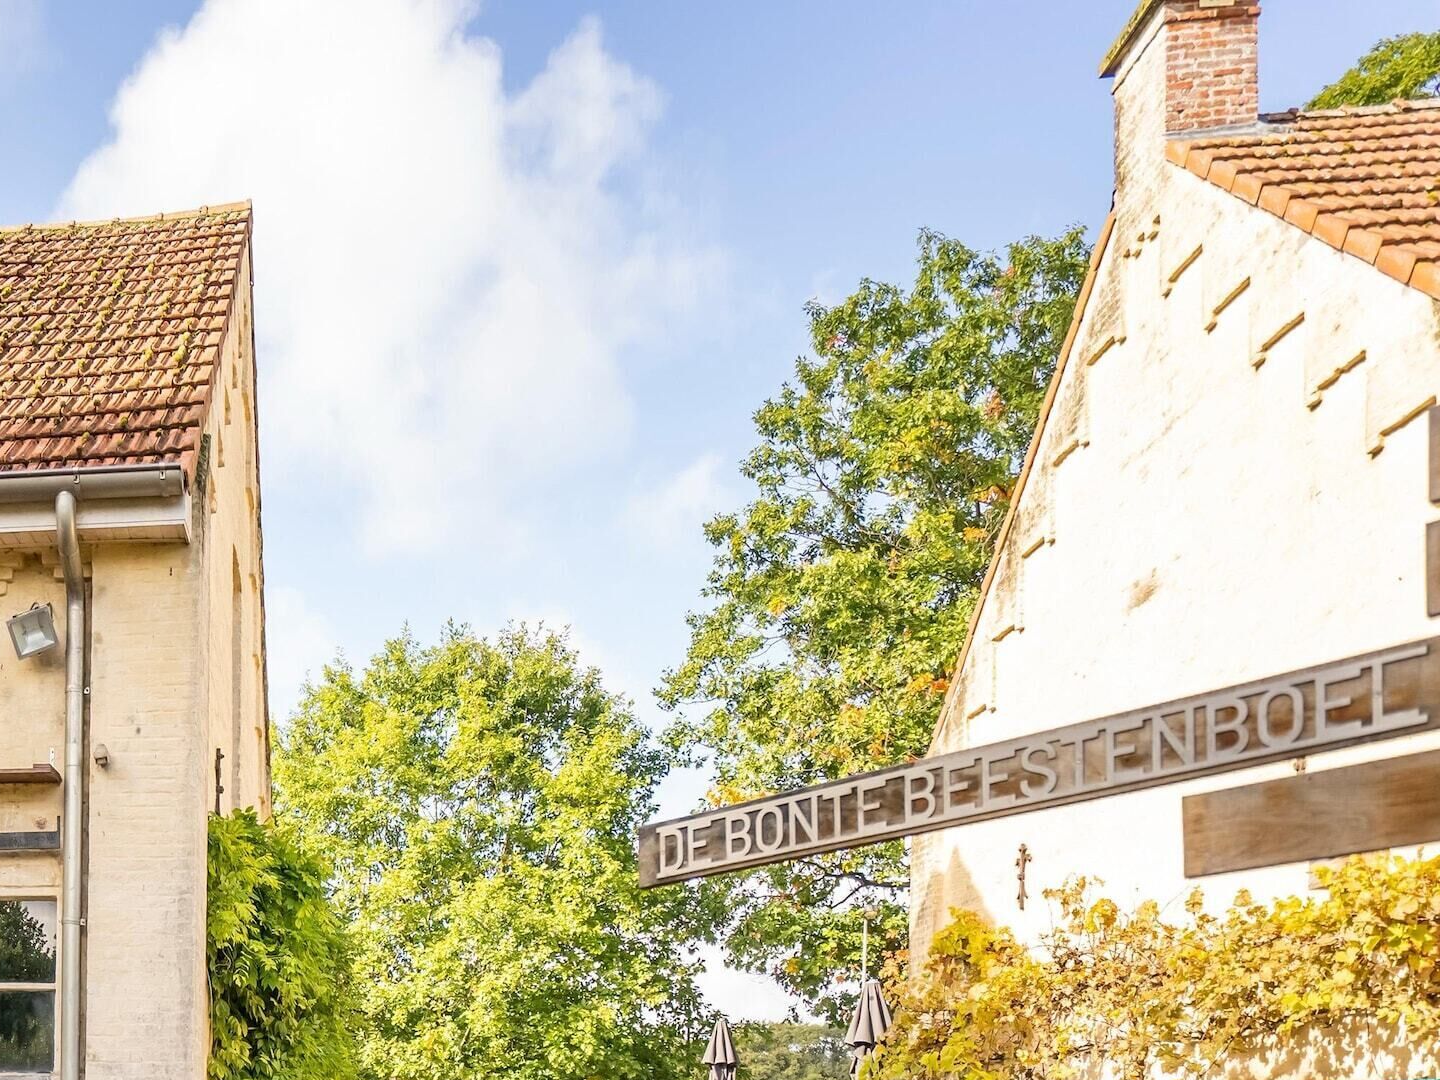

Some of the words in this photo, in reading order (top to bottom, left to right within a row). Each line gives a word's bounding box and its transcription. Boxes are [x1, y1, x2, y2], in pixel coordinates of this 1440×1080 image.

[657, 816, 712, 879] DE
[725, 779, 887, 862] BONTE
[904, 646, 1429, 826] BEESTENBOEL
